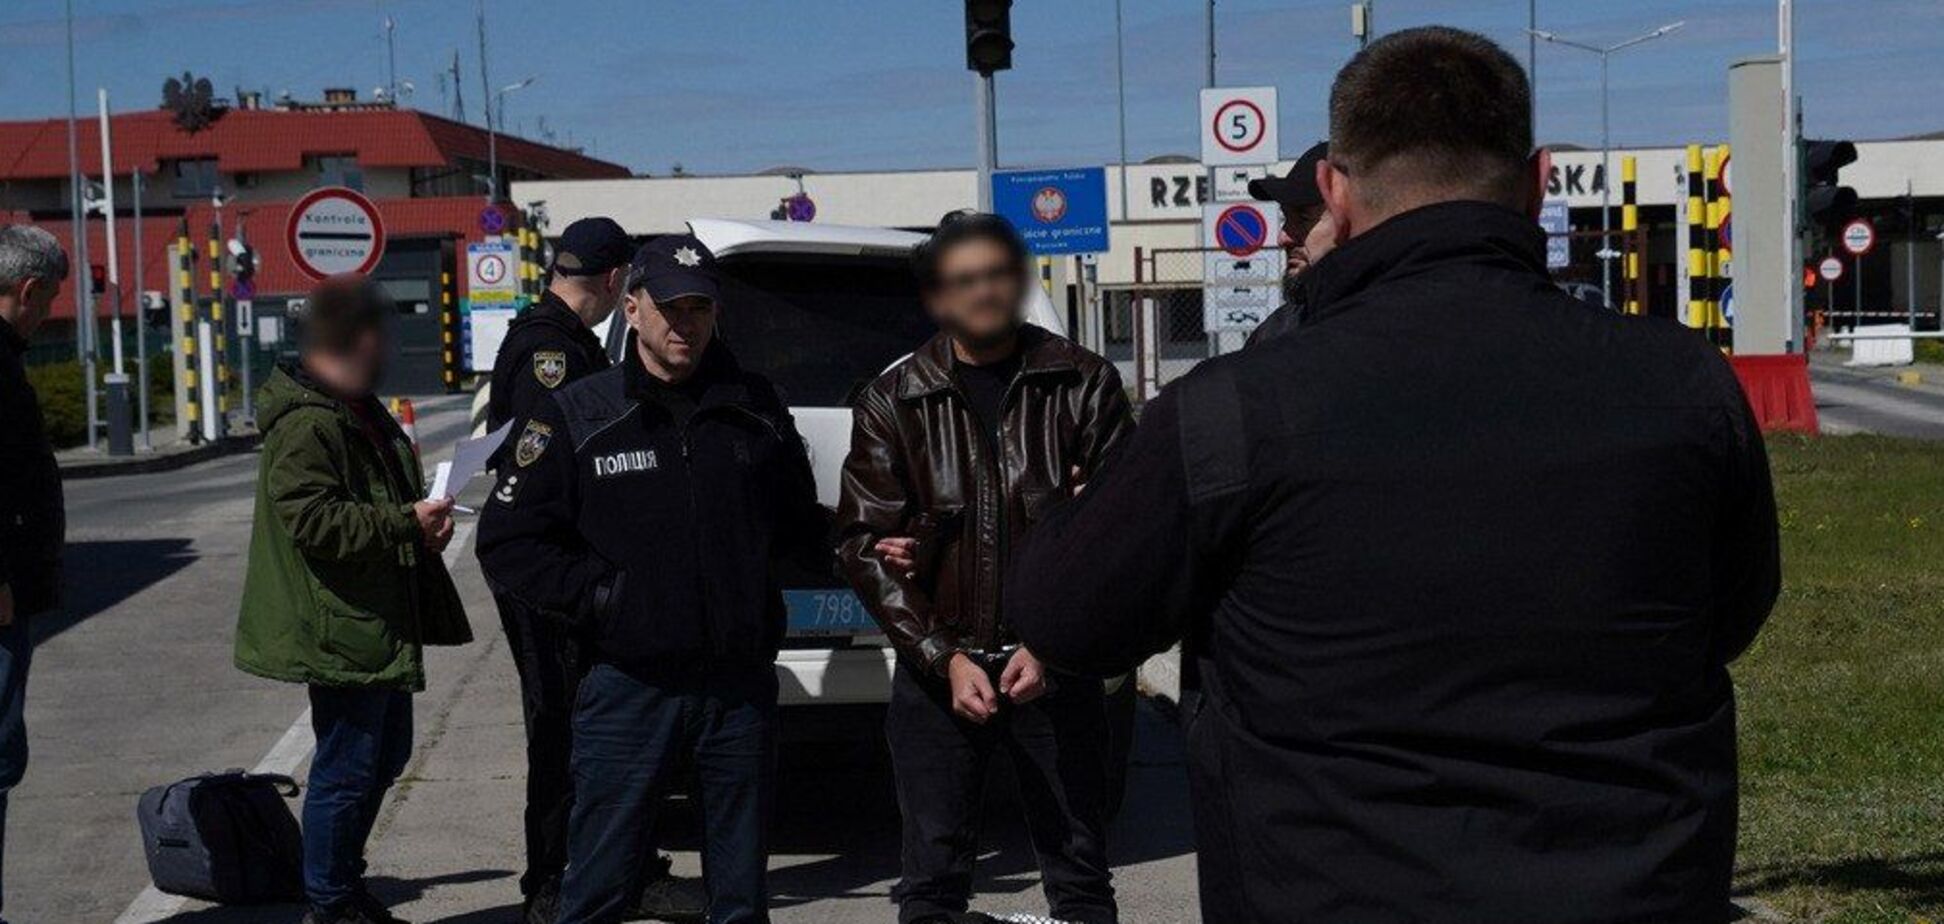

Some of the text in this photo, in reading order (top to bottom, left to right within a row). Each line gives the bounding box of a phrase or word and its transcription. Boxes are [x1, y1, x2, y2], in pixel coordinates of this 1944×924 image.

[1232, 115, 1247, 140] 5
[305, 213, 366, 225] Kontrola
[482, 260, 496, 277] 4
[594, 450, 658, 476] ПОЛІЦІЯ
